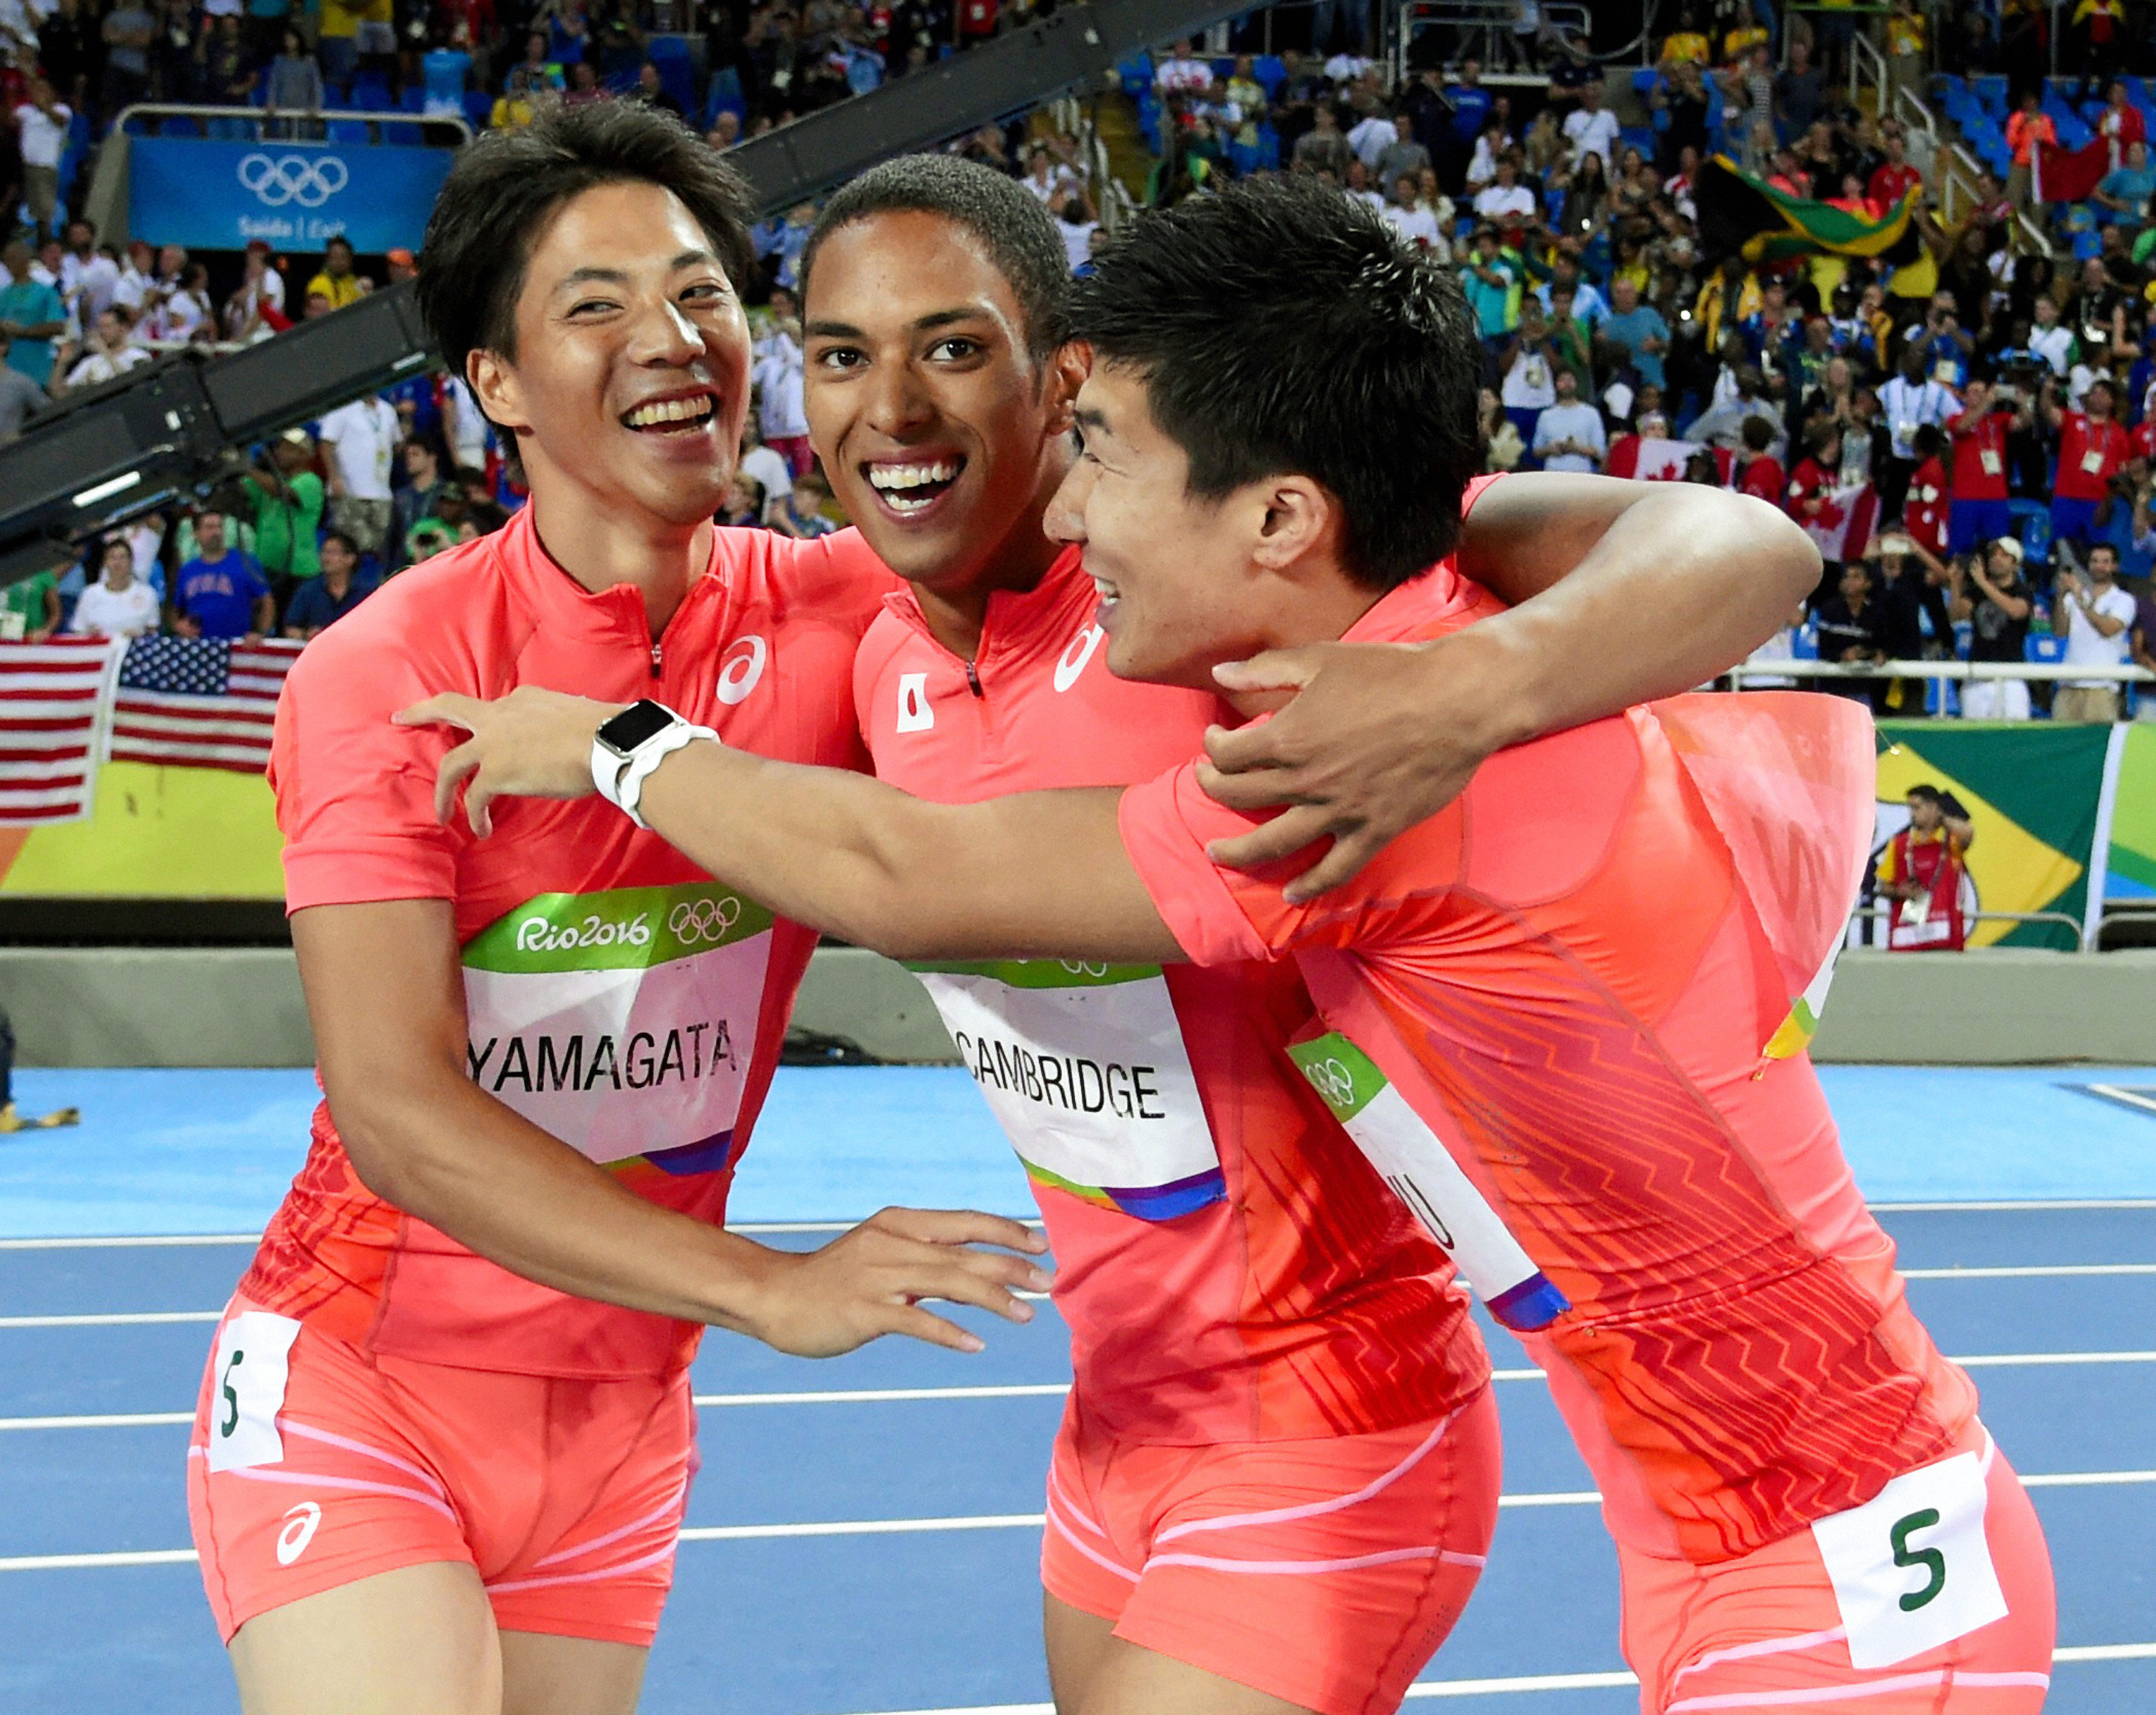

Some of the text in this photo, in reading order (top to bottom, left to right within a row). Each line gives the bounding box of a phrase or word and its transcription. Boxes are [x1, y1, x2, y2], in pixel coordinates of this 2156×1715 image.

[468, 1019, 737, 1092] YAMAGATA
[956, 1031, 1166, 1119] CAMBRIDGE
[221, 1349, 245, 1438] 5
[1889, 1507, 1946, 1612] 5
